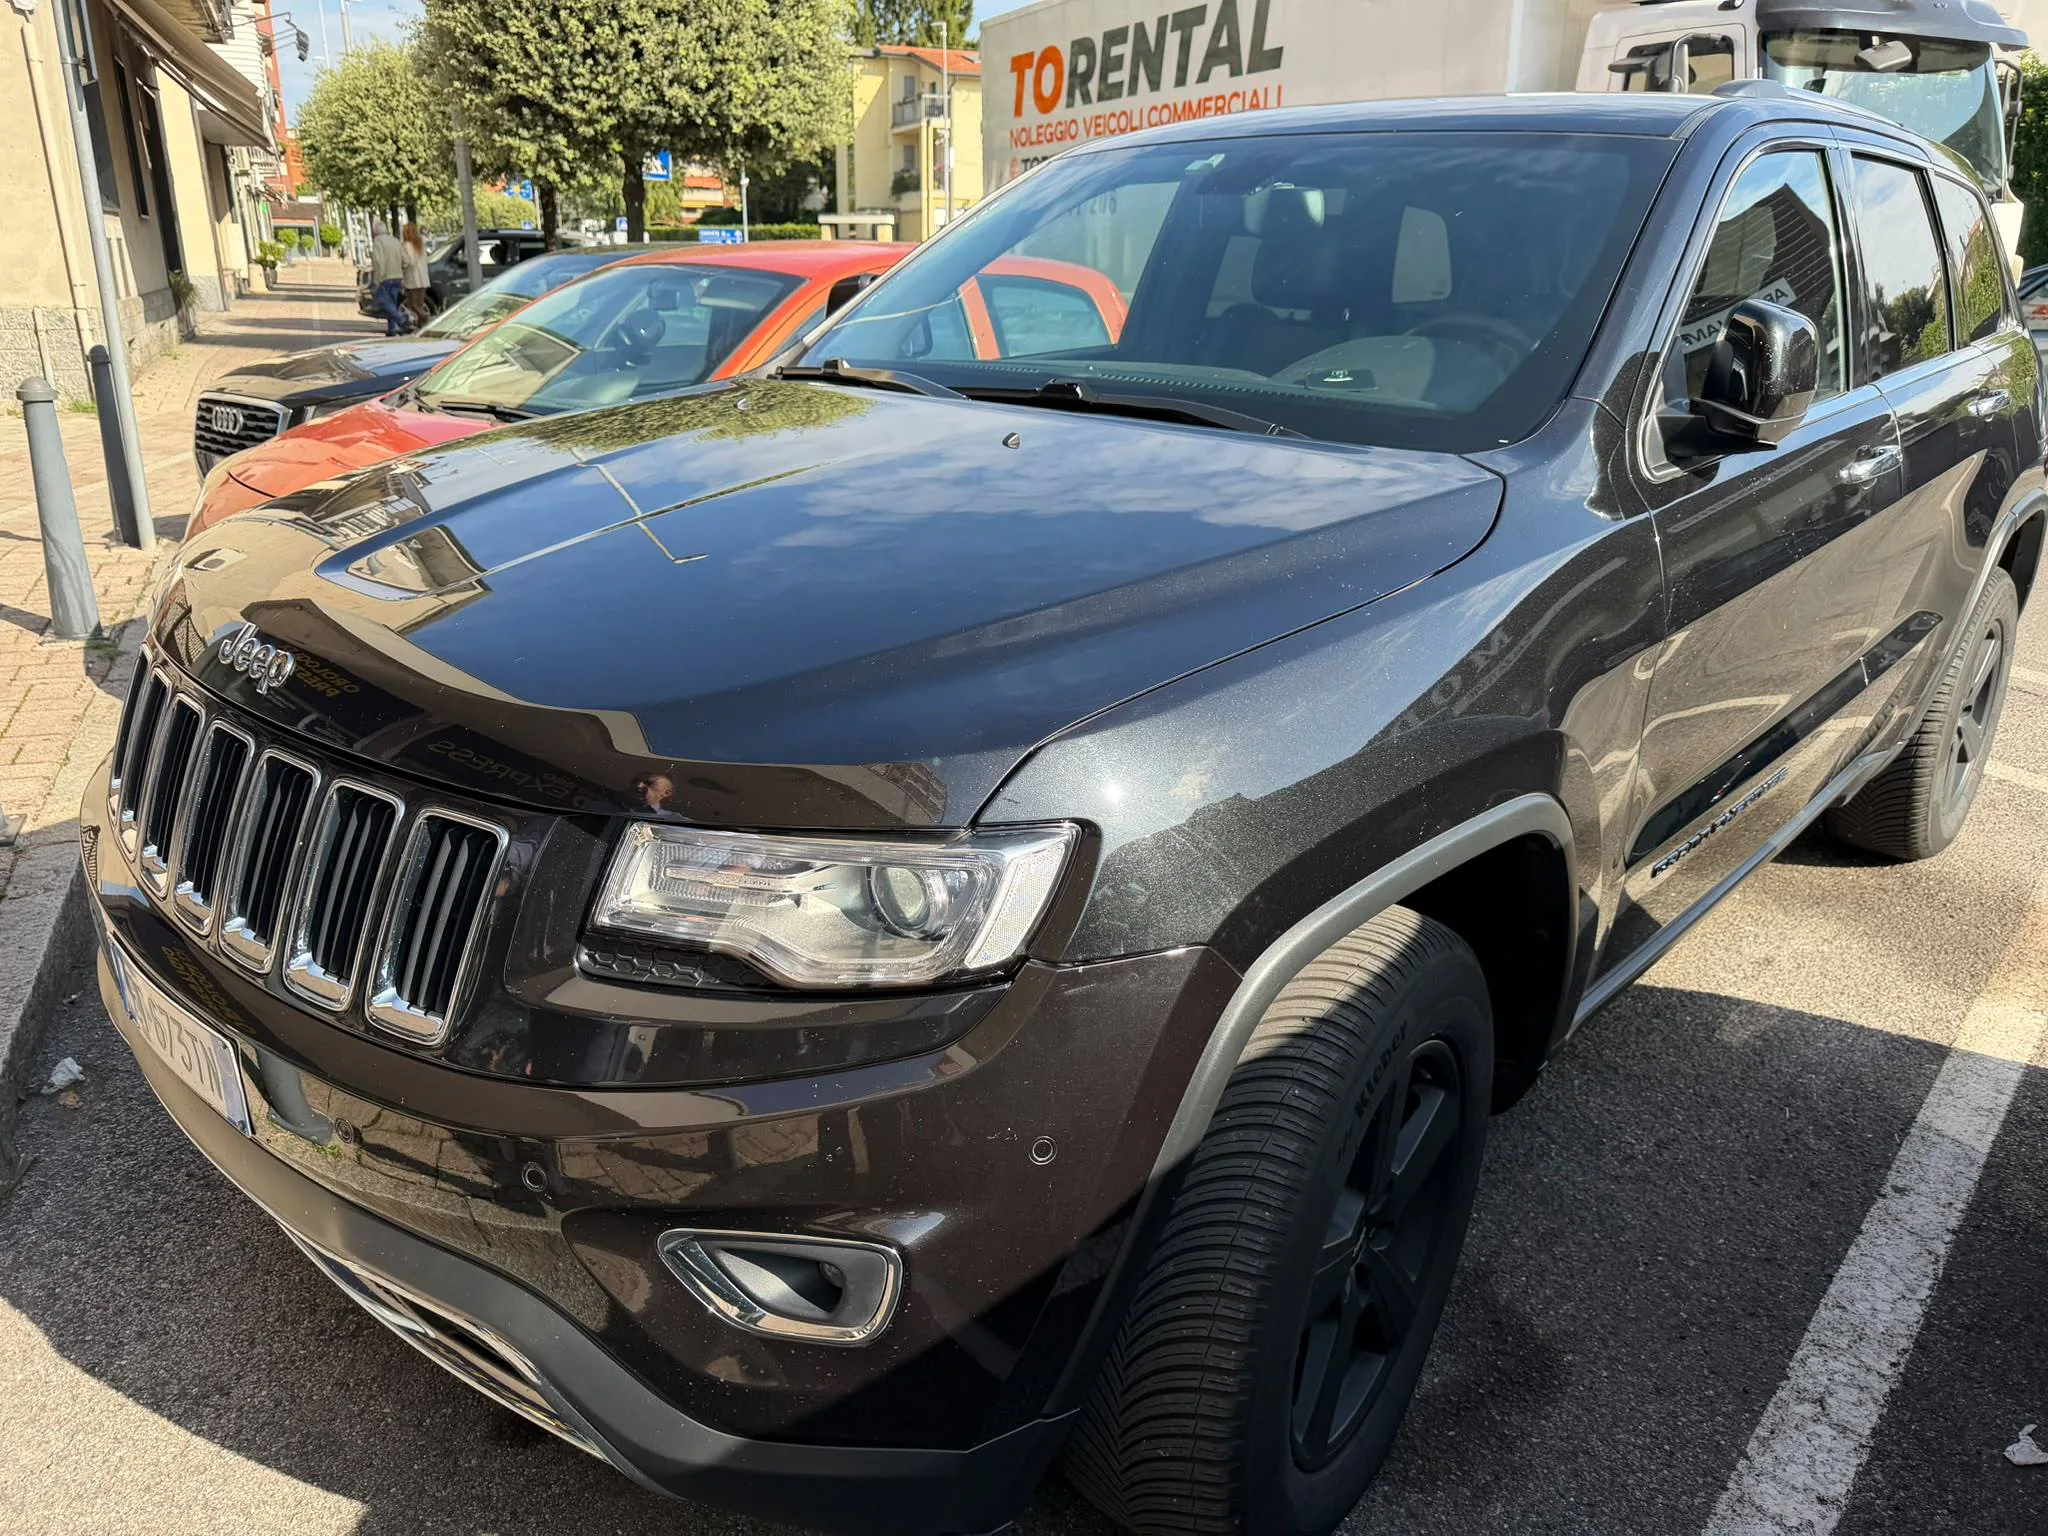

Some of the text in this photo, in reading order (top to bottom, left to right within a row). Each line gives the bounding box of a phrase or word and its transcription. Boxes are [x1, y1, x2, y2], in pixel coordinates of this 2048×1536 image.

[1010, 84, 1282, 148] NOLEGGIO VEICOLI COMMERCIALI
[218, 622, 296, 695] Jeep
[1353, 1018, 1409, 1119] Kleber
